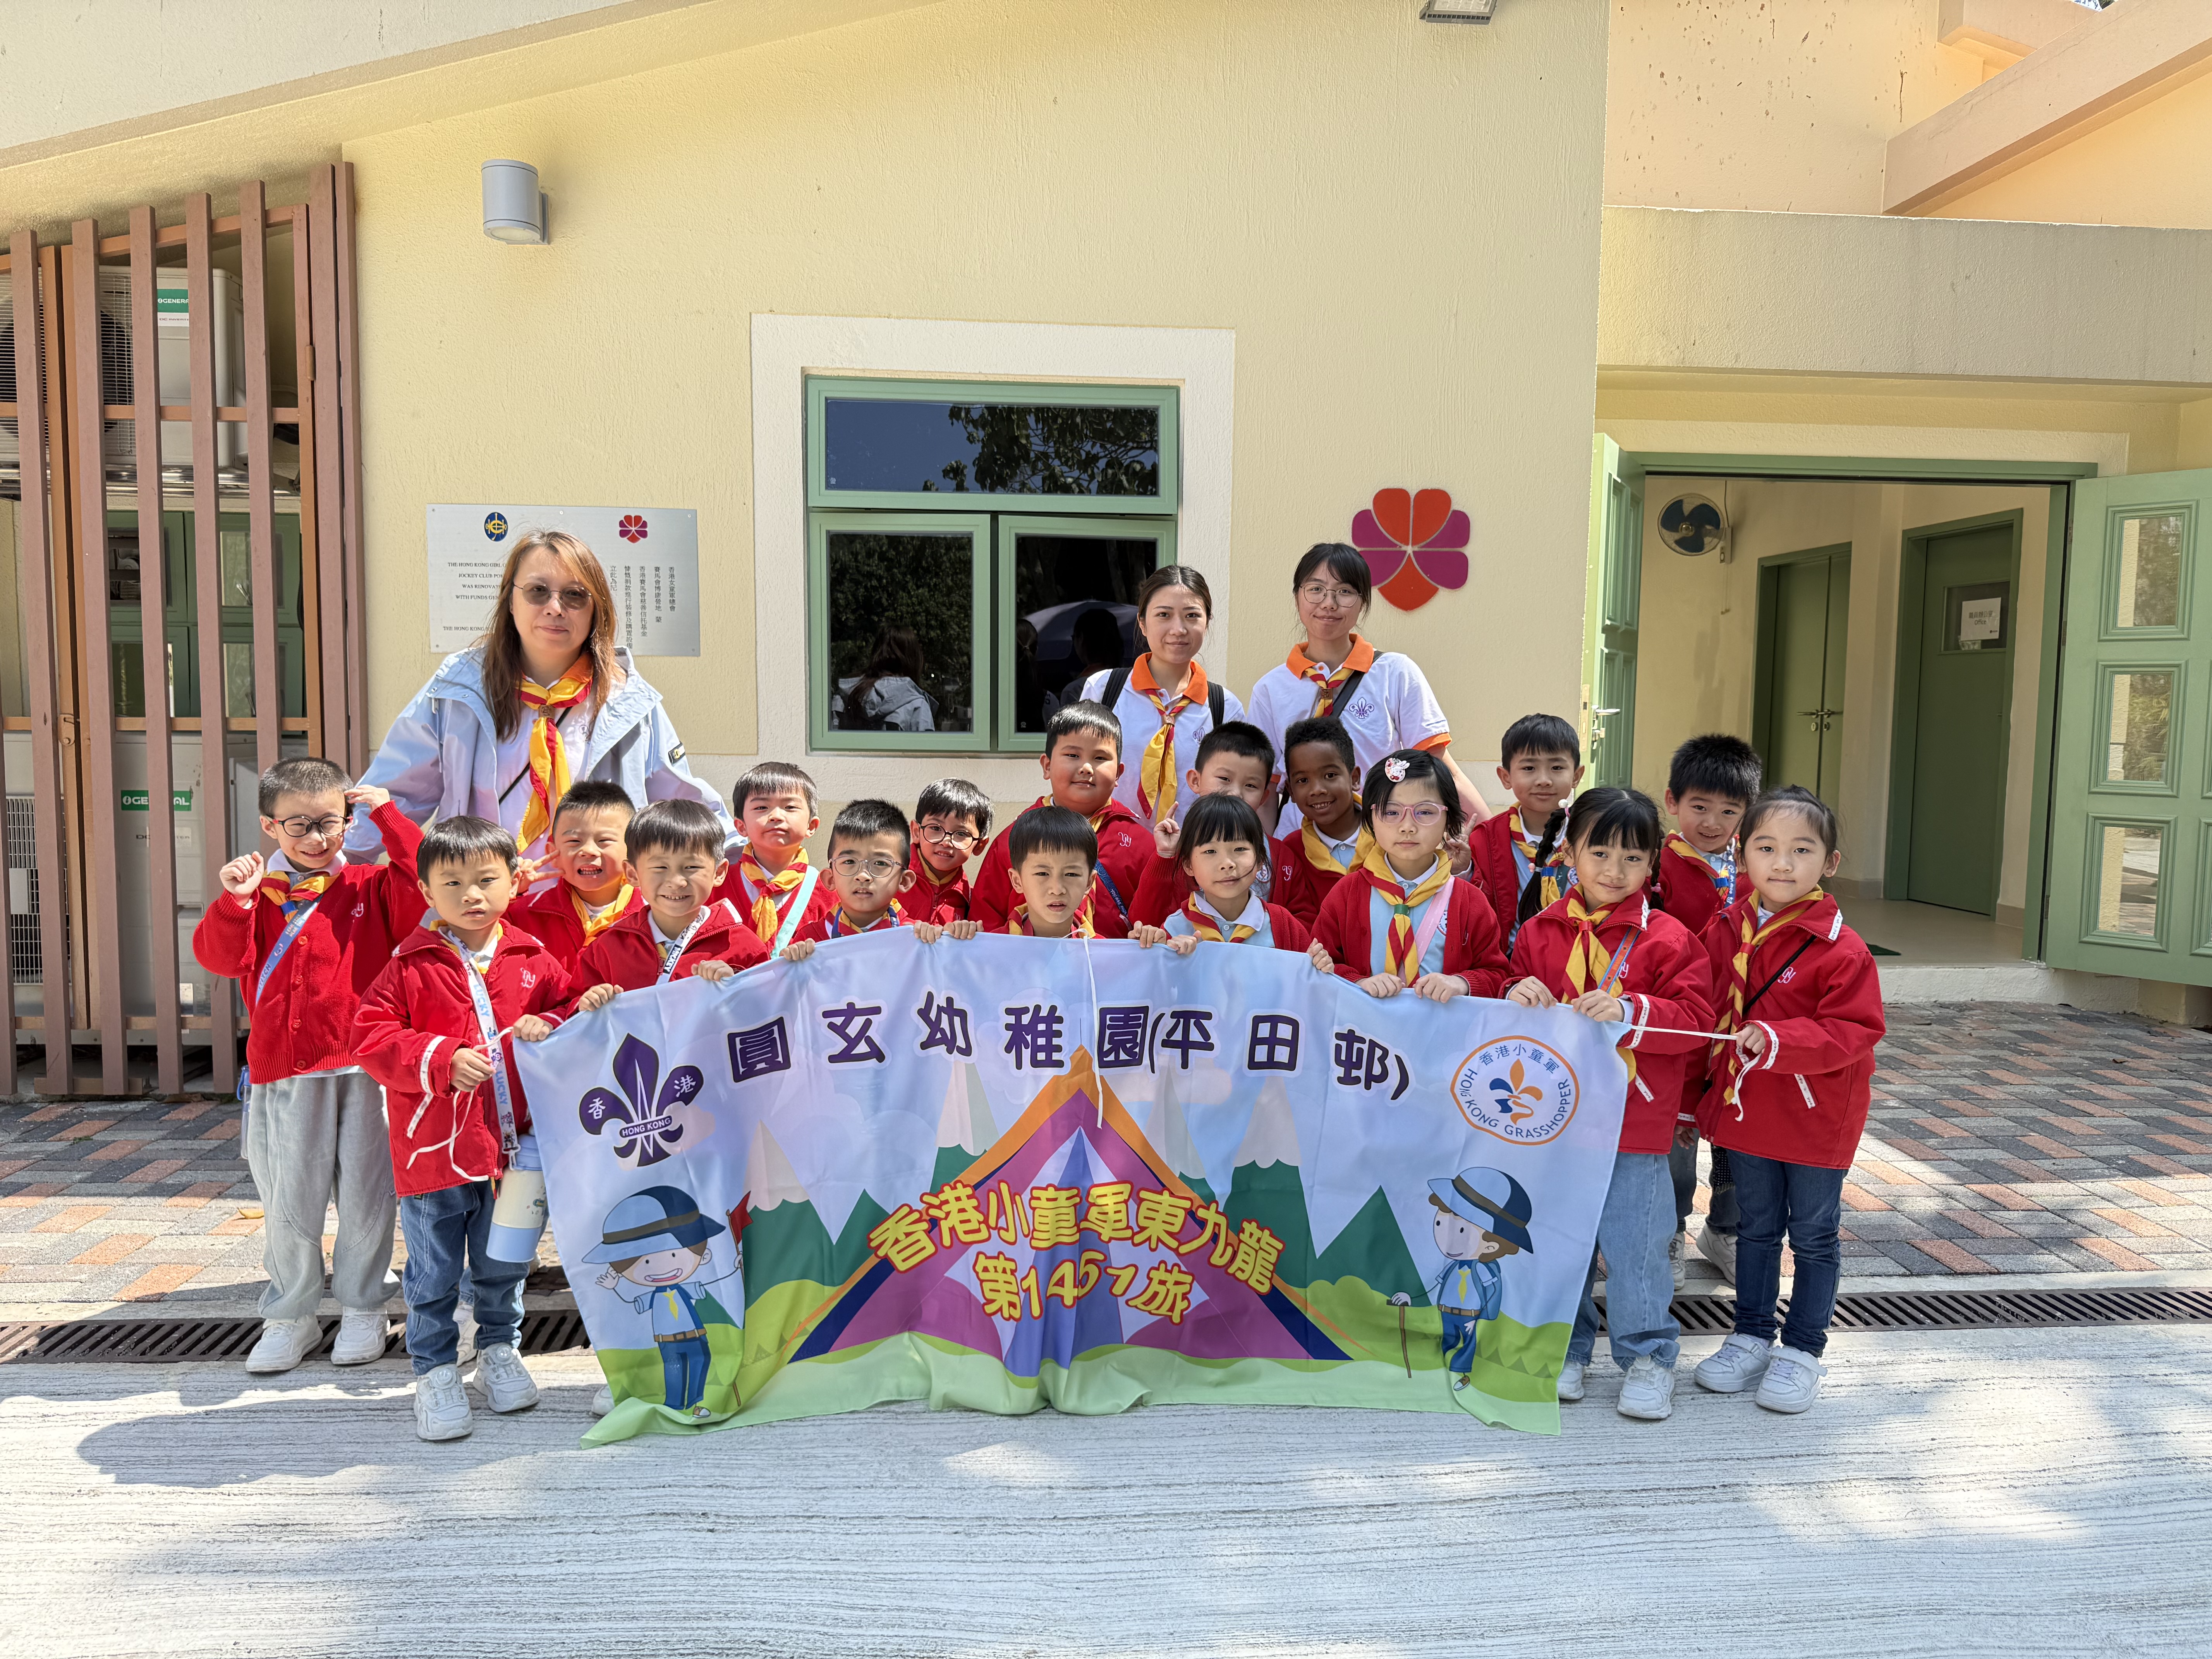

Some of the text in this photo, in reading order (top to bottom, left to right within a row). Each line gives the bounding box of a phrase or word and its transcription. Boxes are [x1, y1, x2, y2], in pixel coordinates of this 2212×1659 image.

[473, 984, 490, 1017] LUCKY
[1479, 1043, 1559, 1074] 香港小童軍
[495, 1071, 508, 1104] LUCKY
[1459, 1068, 1571, 1138] HONG KONG GRASSHOPPER
[622, 1117, 671, 1137] HONG KONG
[867, 1180, 1285, 1295] 香港小童軍東九龍
